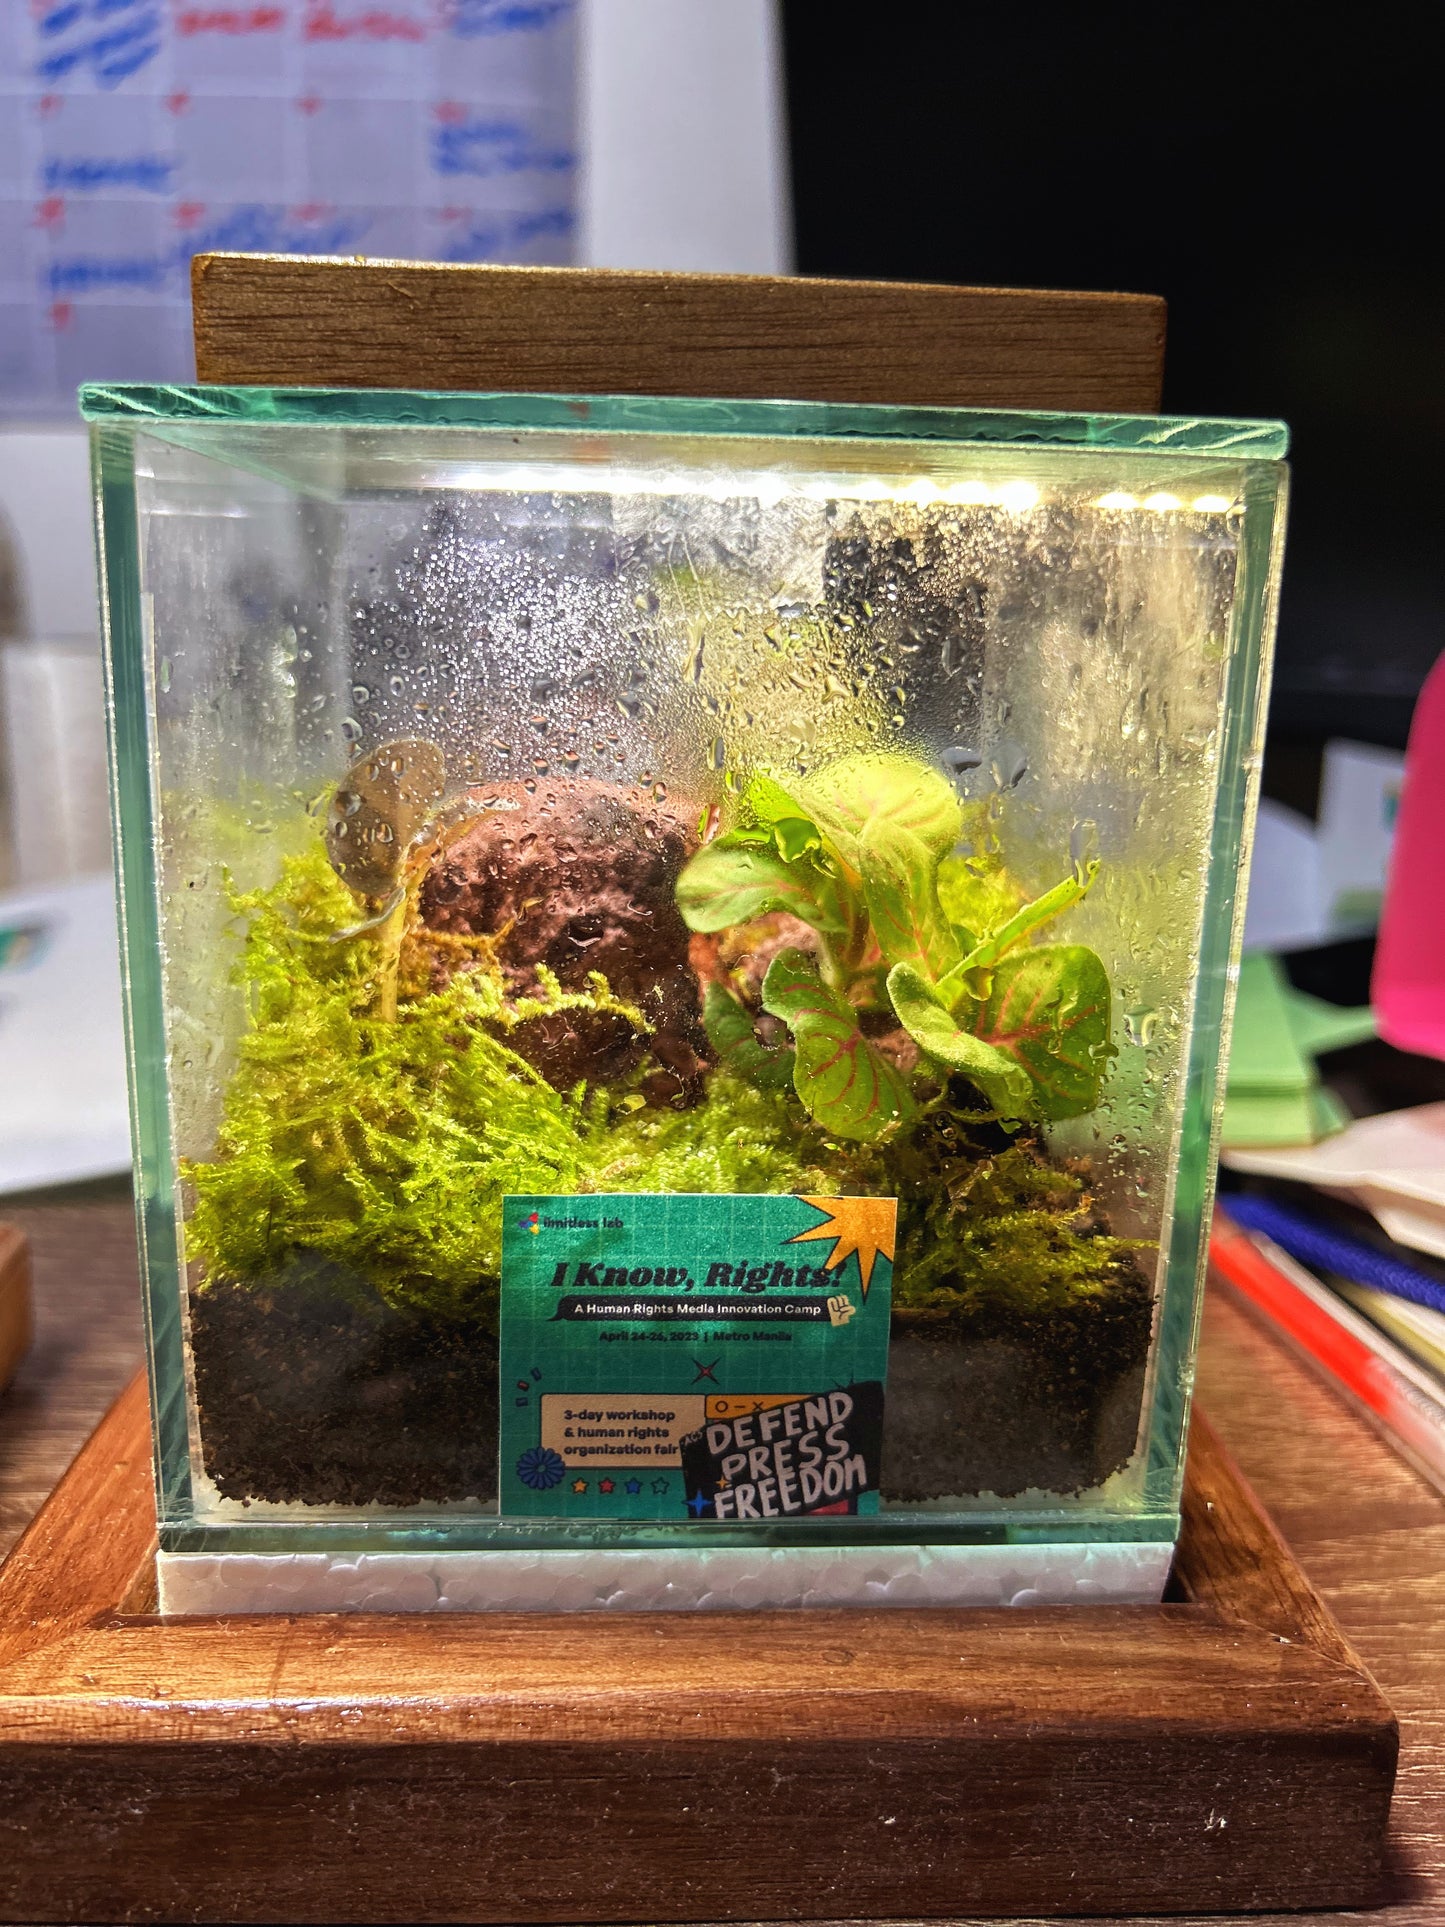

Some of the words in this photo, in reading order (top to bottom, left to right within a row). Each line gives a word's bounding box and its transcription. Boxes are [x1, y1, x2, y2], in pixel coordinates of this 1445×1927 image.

[543, 1216, 598, 1228] limitless
[604, 1216, 623, 1228] lab
[550, 1262, 569, 1286] I
[573, 1262, 695, 1292] Know,
[703, 1260, 847, 1293] Rights!
[574, 1304, 584, 1314] A
[587, 1304, 631, 1314] Human
[634, 1303, 674, 1316] Rights
[676, 1303, 714, 1314] Media
[717, 1303, 781, 1314] Innovation
[785, 1304, 821, 1316] Camp
[600, 1331, 628, 1343] April
[631, 1332, 667, 1342] 24-26,
[670, 1332, 699, 1341] 2023
[713, 1332, 750, 1341] Metro
[753, 1331, 792, 1341] Manila
[564, 1410, 604, 1422] 3-day
[606, 1410, 675, 1422] workshop
[706, 1392, 853, 1455] DEFEND
[564, 1427, 575, 1437] &
[578, 1427, 625, 1438] human
[627, 1427, 669, 1439] rights
[564, 1444, 651, 1456] organization
[654, 1444, 678, 1455] fair
[721, 1423, 851, 1480] PRESS
[714, 1454, 867, 1519] FREEDOM
